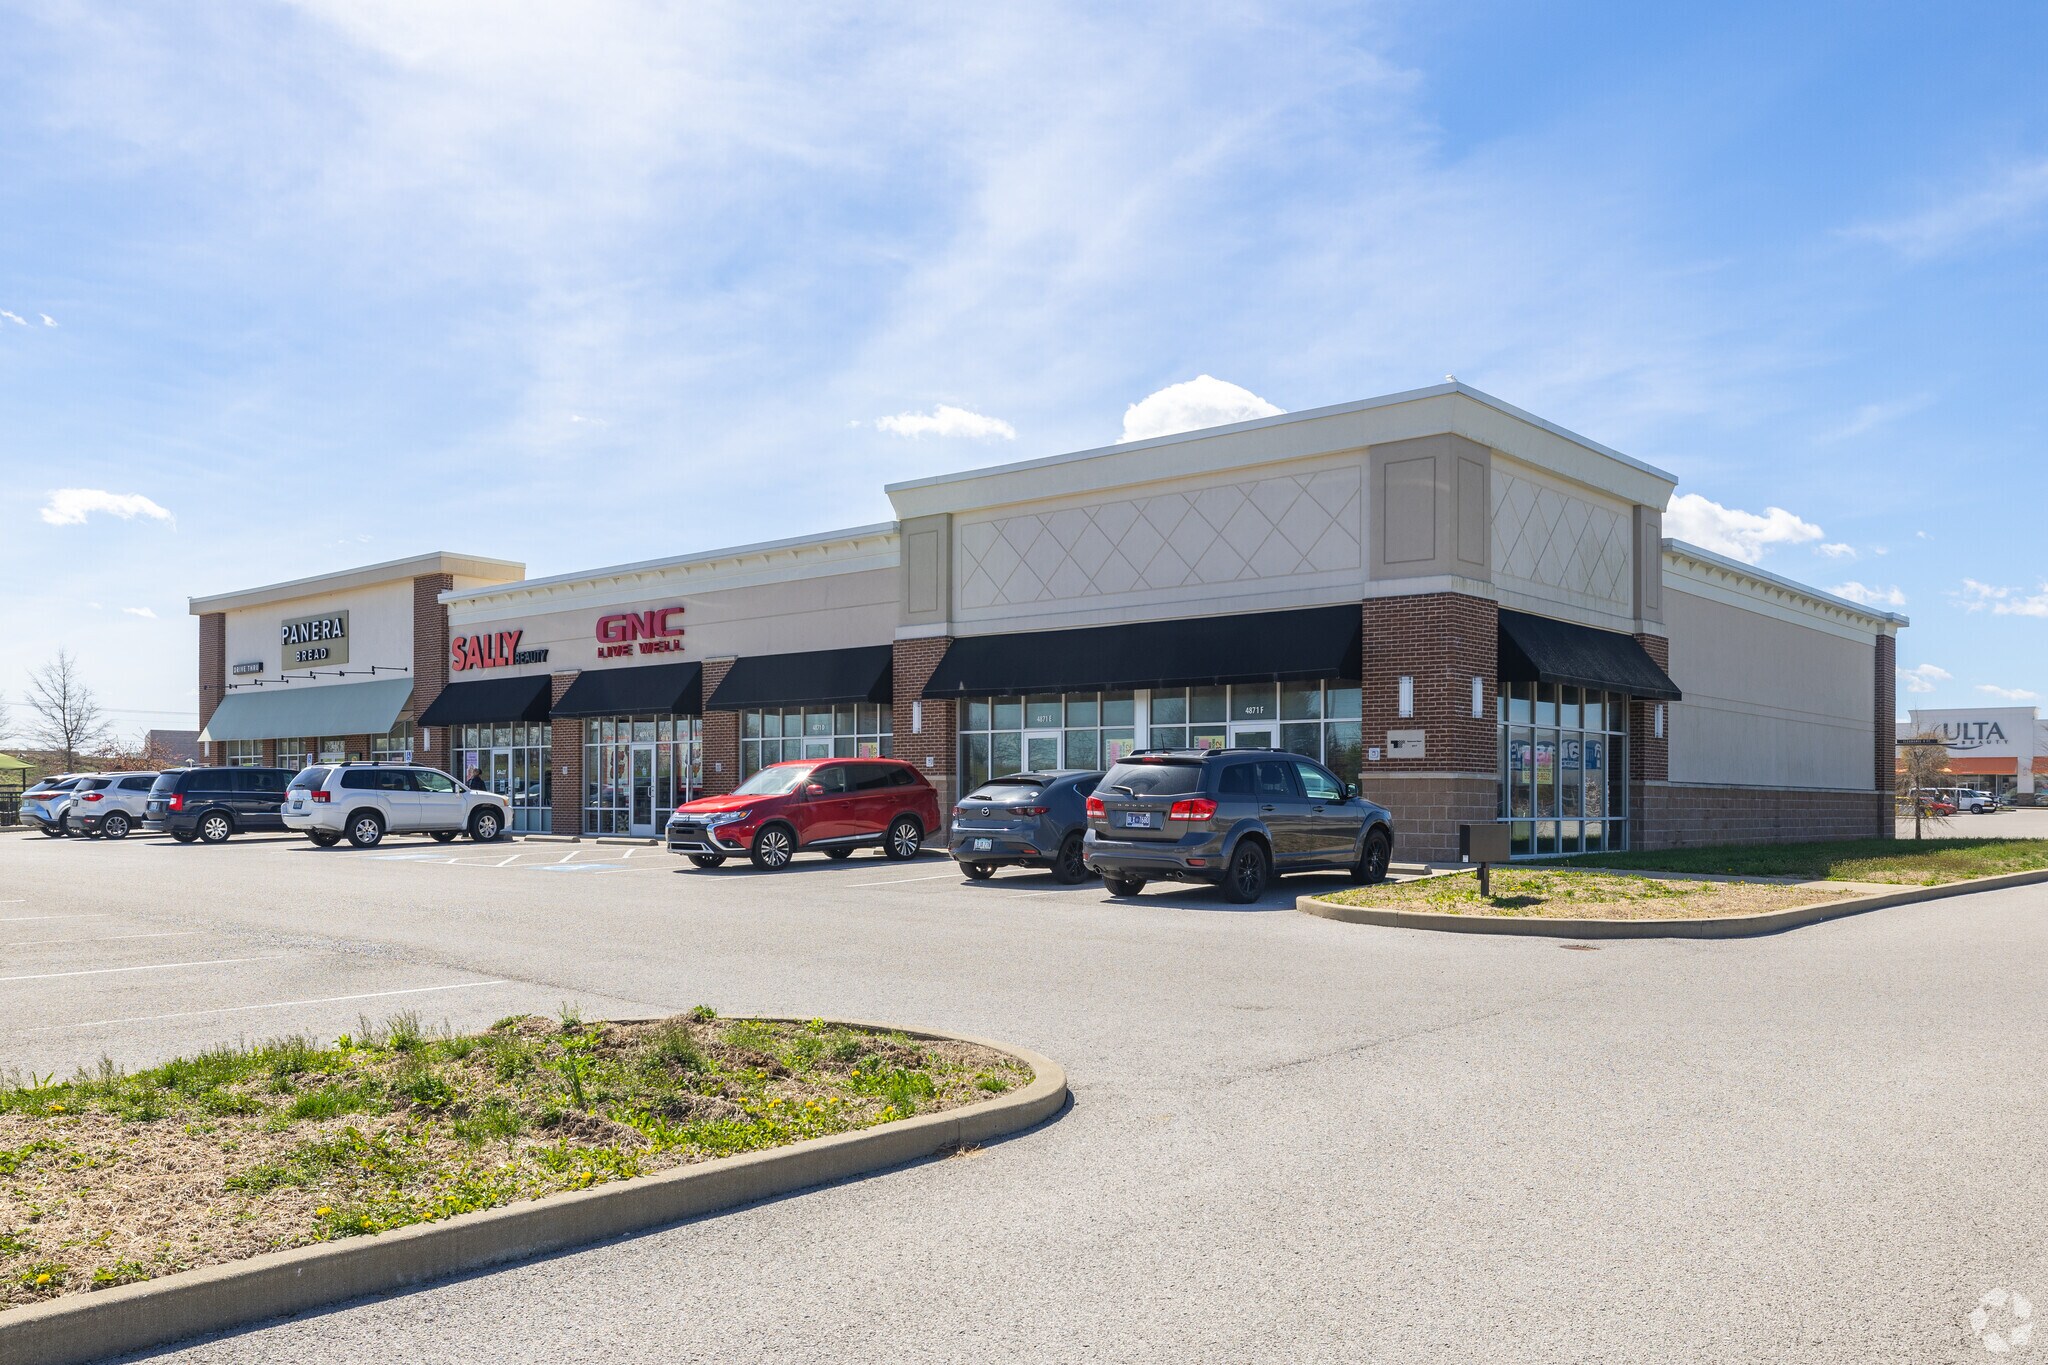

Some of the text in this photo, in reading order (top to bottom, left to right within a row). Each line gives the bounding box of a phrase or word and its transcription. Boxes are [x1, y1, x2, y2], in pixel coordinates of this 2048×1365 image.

[281, 618, 343, 645] PANERA
[596, 607, 684, 643] GNC
[295, 648, 328, 662] BREAD
[452, 630, 522, 671] SALLY
[515, 649, 549, 664] BEAUTY
[598, 639, 685, 658] LIVE WELL
[1245, 706, 1259, 714] 4871
[1943, 722, 2005, 740] ULTA
